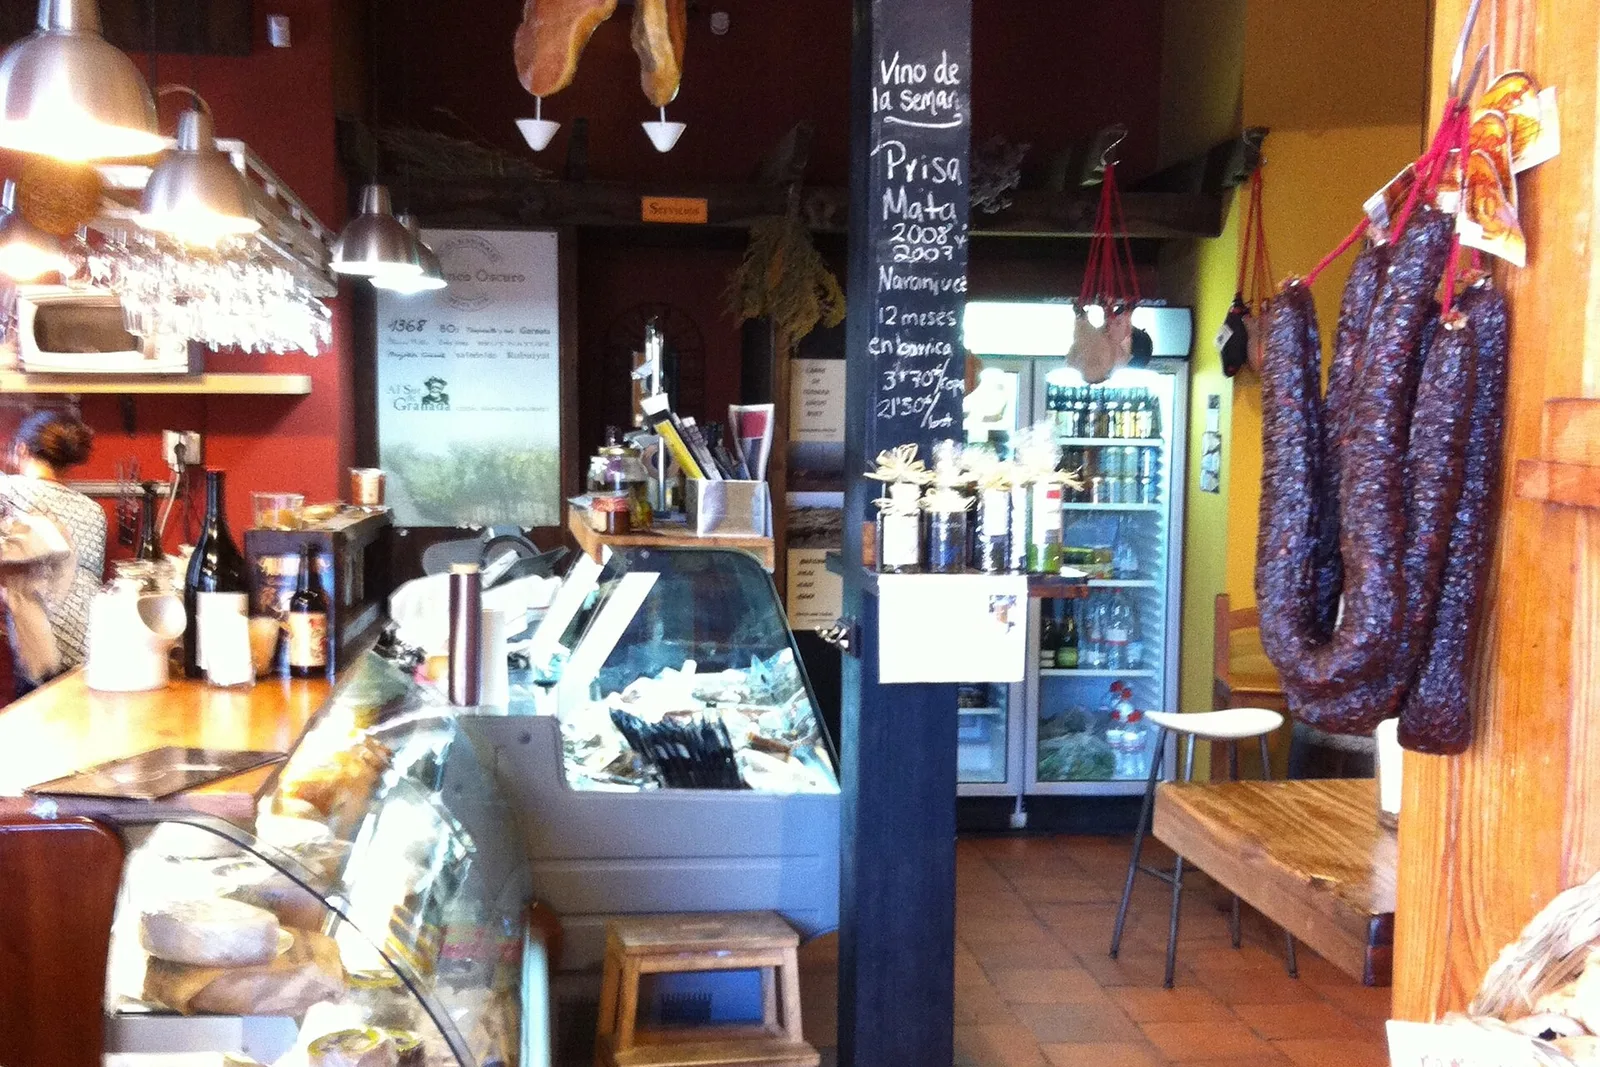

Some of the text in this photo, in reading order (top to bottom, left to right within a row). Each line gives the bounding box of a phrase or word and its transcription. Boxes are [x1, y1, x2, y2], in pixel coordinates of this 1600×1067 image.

[881, 49, 960, 85] Vino de
[872, 86, 893, 113] la
[871, 140, 963, 186] Prisa
[882, 185, 958, 222] Mata
[889, 222, 953, 245] 2008
[892, 243, 953, 263] 2007
[388, 319, 427, 332] 1368
[879, 305, 957, 327] 12 meses
[868, 336, 894, 356] en
[393, 397, 450, 411] Granada
